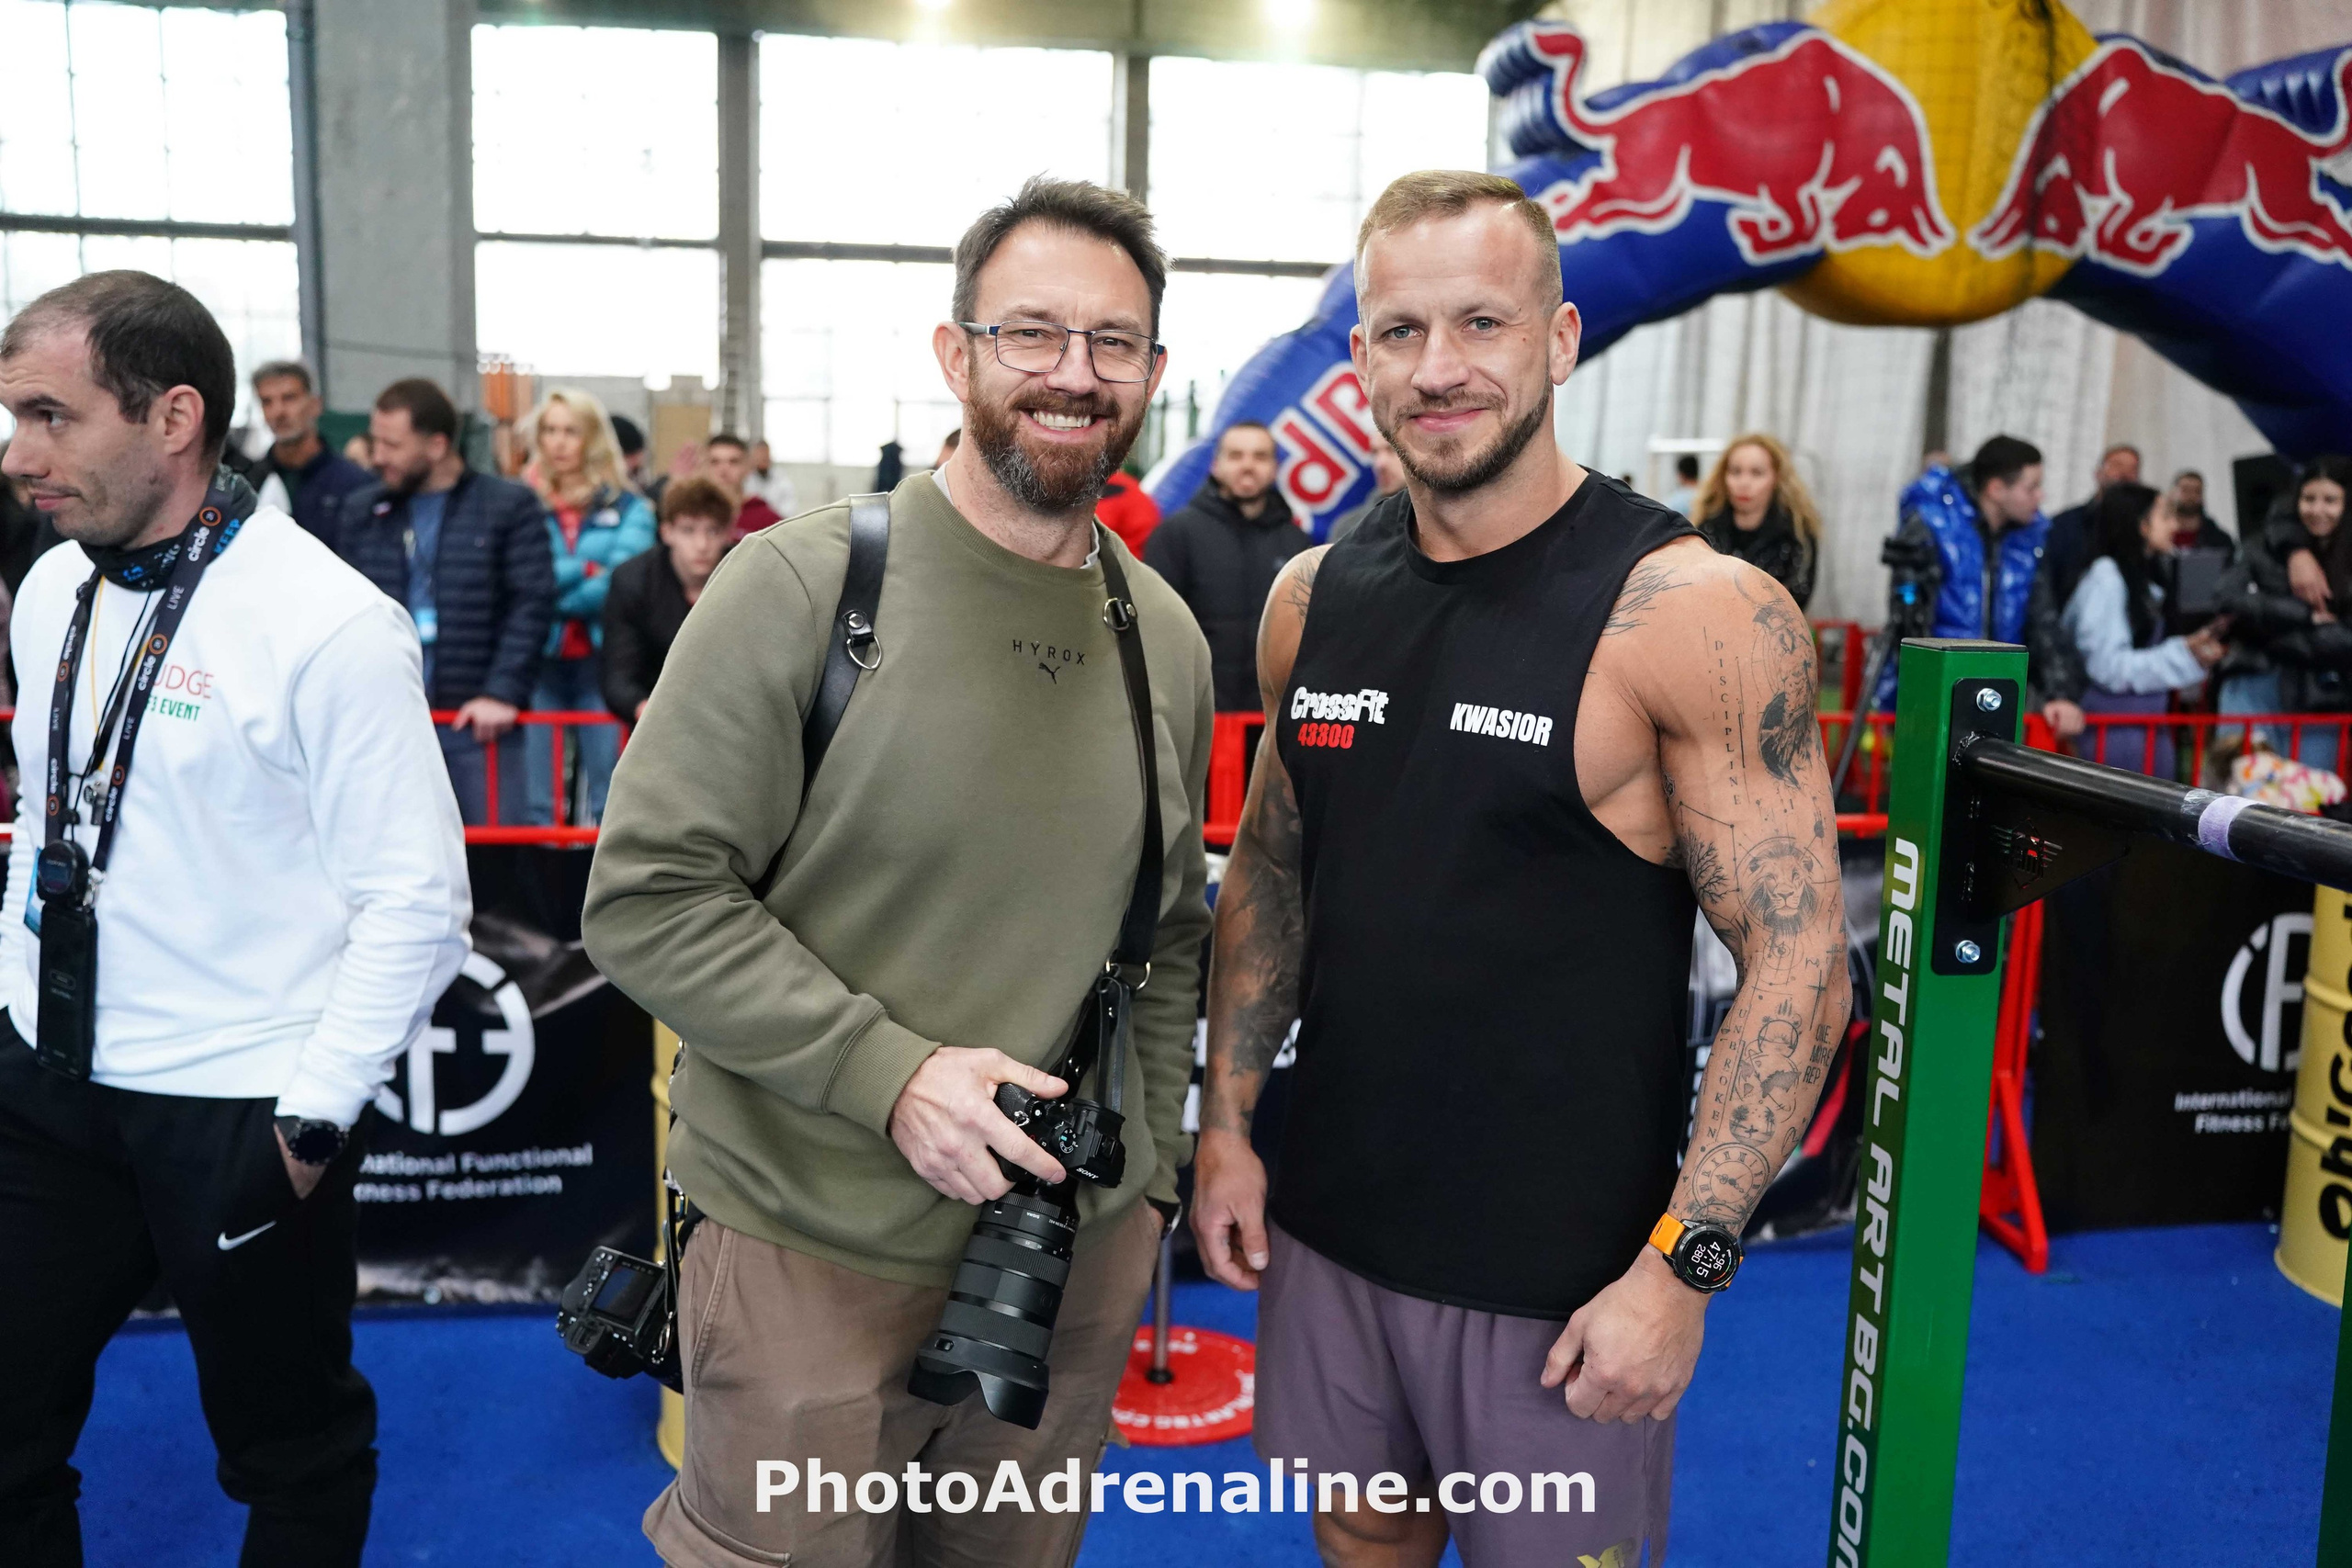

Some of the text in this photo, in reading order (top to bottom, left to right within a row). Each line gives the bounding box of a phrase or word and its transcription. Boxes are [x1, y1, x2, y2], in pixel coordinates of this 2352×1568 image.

[187, 525, 210, 563] circle
[166, 584, 186, 611] LIVE
[1012, 638, 1086, 666] HYROX
[137, 654, 157, 692] circle
[153, 663, 215, 699] UDGE
[159, 698, 201, 722] EVENT
[1290, 686, 1389, 725] CrossFit
[1449, 702, 1554, 747] KWASIOR
[1713, 639, 1743, 807] DISCIPLINE
[105, 786, 118, 823] circle
[1871, 837, 1920, 1128] METAL
[1809, 1043, 1833, 1067] MORE
[1706, 1008, 1749, 1140] UNBROKEN
[1803, 1065, 1822, 1085] REP
[461, 1142, 594, 1173] Functional
[1076, 1167, 1100, 1179] SONY
[425, 1172, 563, 1201] Federation
[1690, 1244, 1706, 1264] 280
[1696, 1241, 1722, 1278] 47:15
[1713, 1257, 1725, 1271] 96
